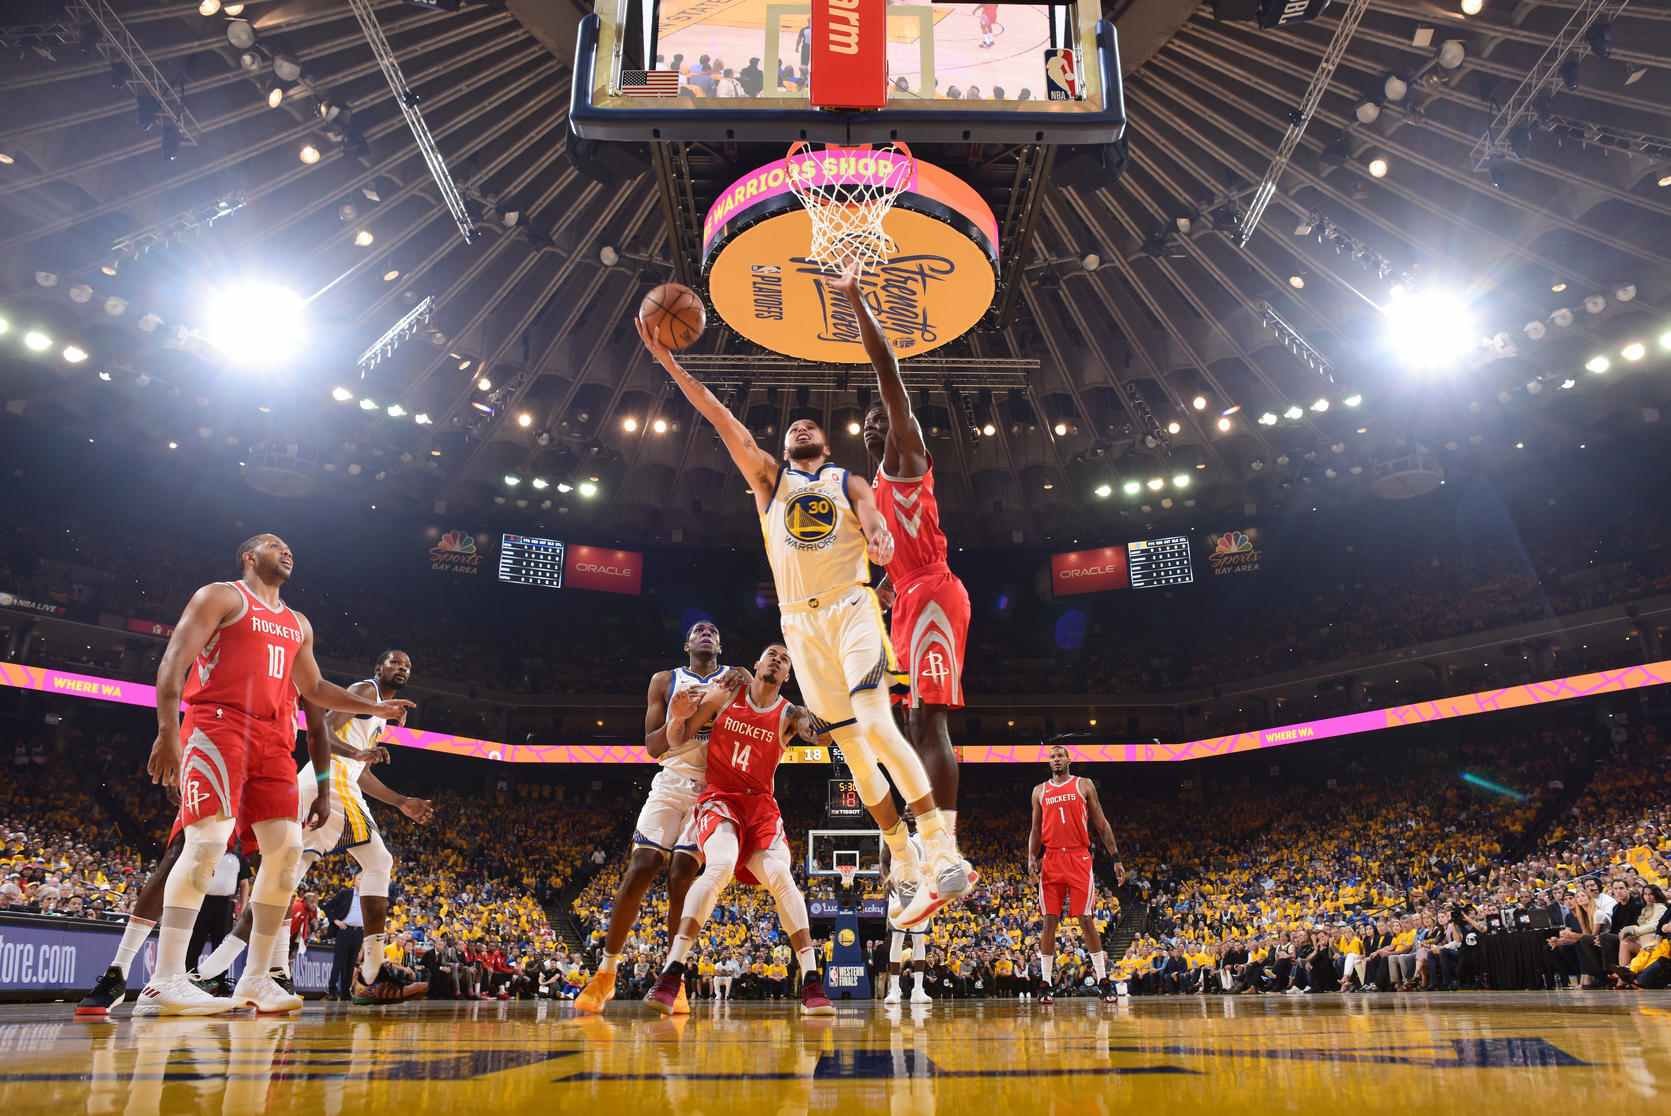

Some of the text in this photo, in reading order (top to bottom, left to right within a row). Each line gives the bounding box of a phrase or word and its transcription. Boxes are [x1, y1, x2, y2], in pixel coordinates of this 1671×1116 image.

[713, 159, 816, 224] WARRIORS
[823, 157, 894, 177] SHOP
[751, 274, 783, 320] PLAYOFFS
[808, 500, 830, 514] 30
[785, 534, 838, 551] WARRIORS
[575, 562, 633, 577] ORACLE
[1059, 564, 1117, 579] ORACLE
[250, 616, 301, 643] ROCKETS
[267, 643, 285, 679] 10
[53, 676, 122, 697] WHERE WA
[724, 716, 775, 743] ROCKETS
[1265, 727, 1314, 744] WHERE WA
[731, 740, 753, 772] 14
[804, 749, 822, 761] 18
[1045, 793, 1077, 806] ROCKETS
[1059, 806, 1066, 825] 1
[839, 966, 865, 977] WESTERN
[839, 976, 859, 987] FINALS
